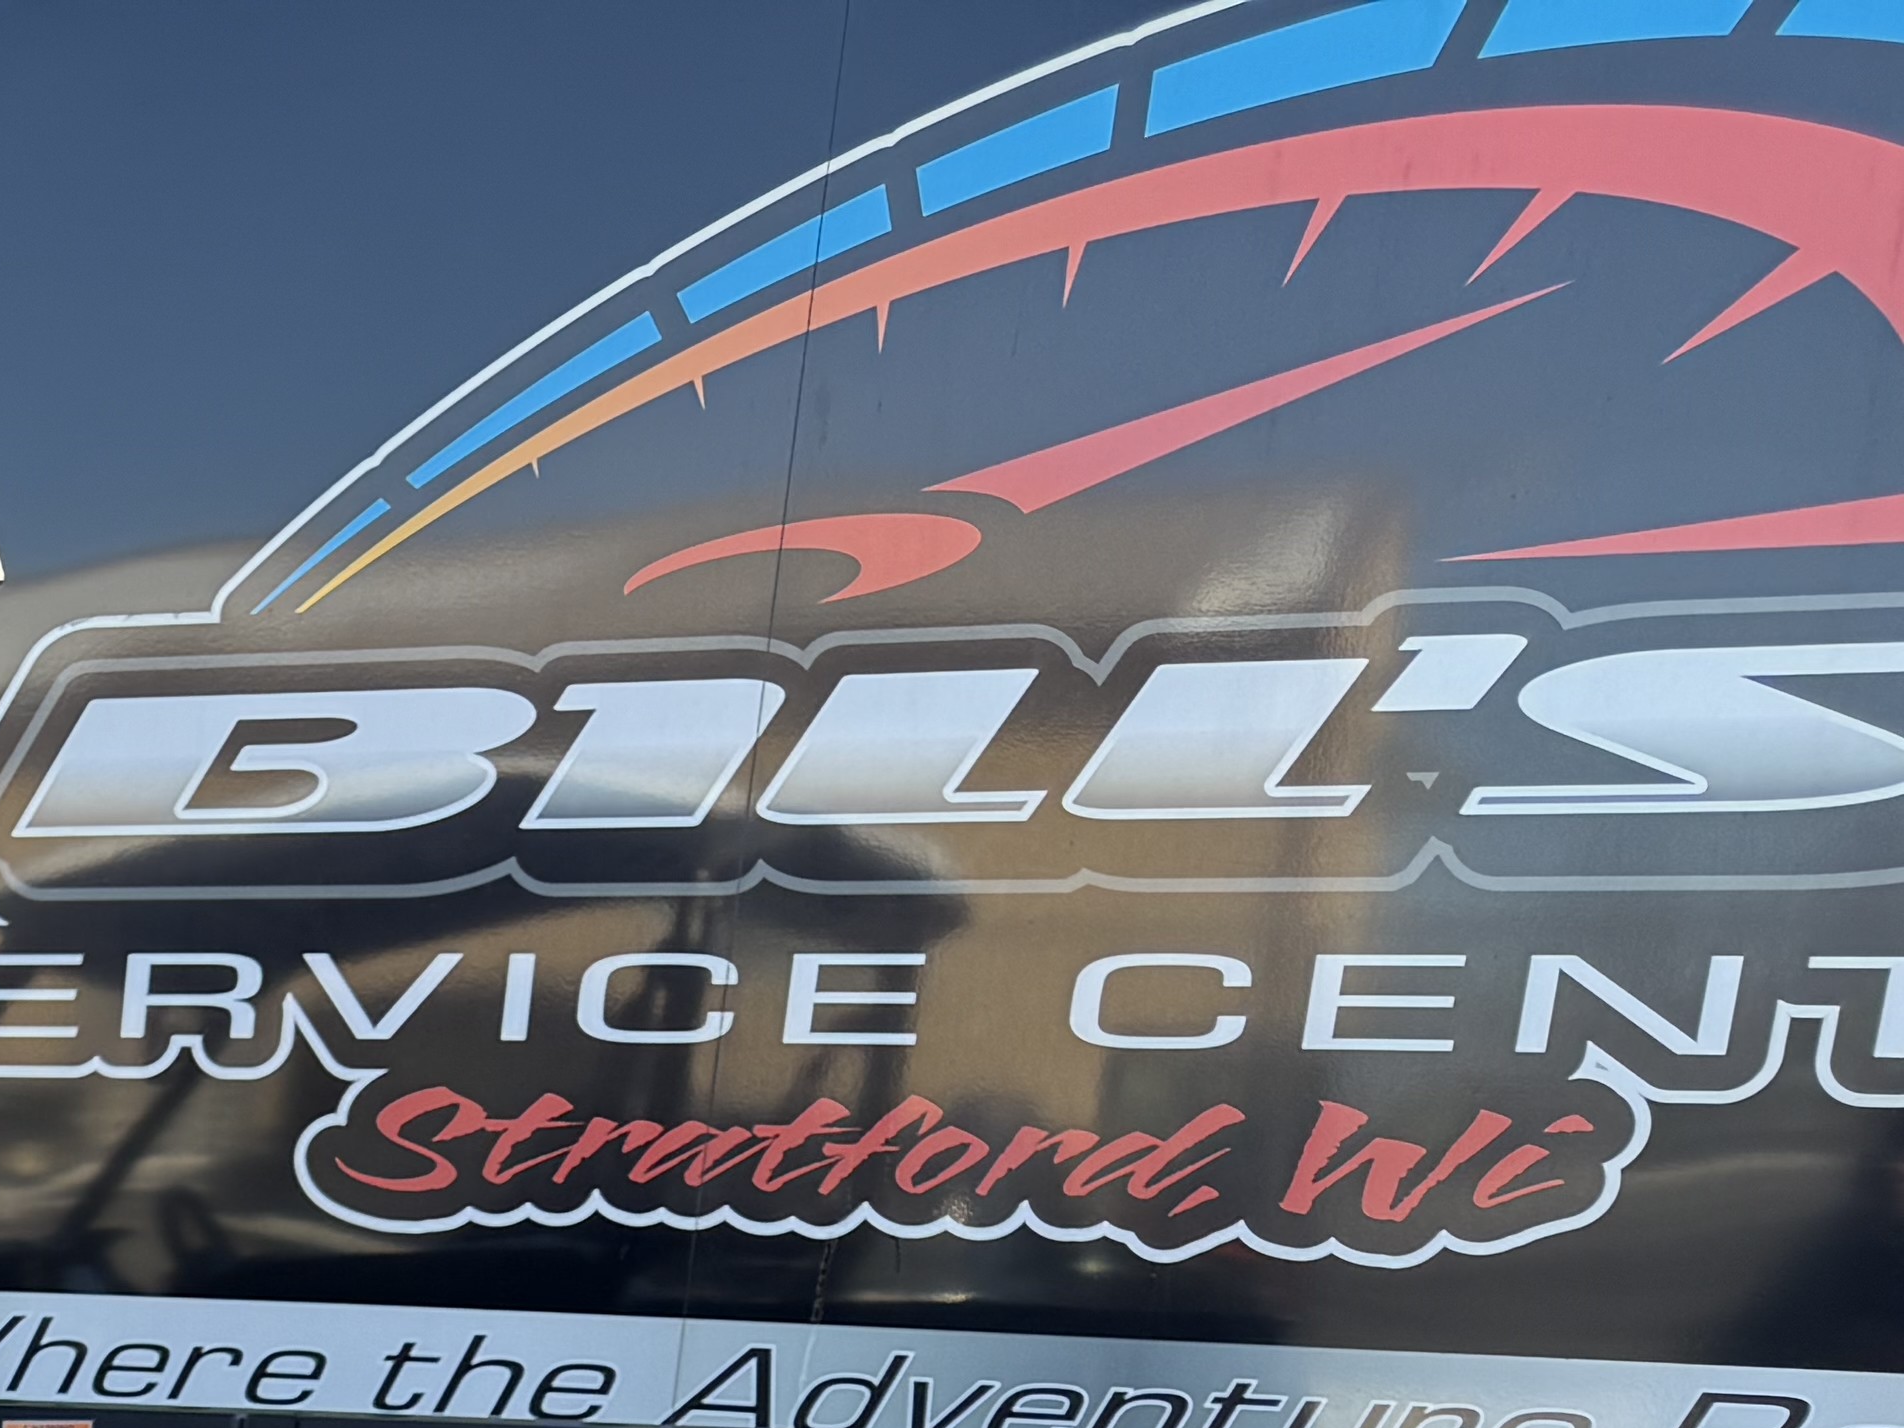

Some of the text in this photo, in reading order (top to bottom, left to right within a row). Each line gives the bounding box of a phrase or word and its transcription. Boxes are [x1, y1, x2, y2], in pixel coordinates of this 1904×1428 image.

[11, 632, 1904, 837] BILL'S
[335, 1086, 1594, 1221] Stratford, Wi
[382, 1332, 619, 1424] the
